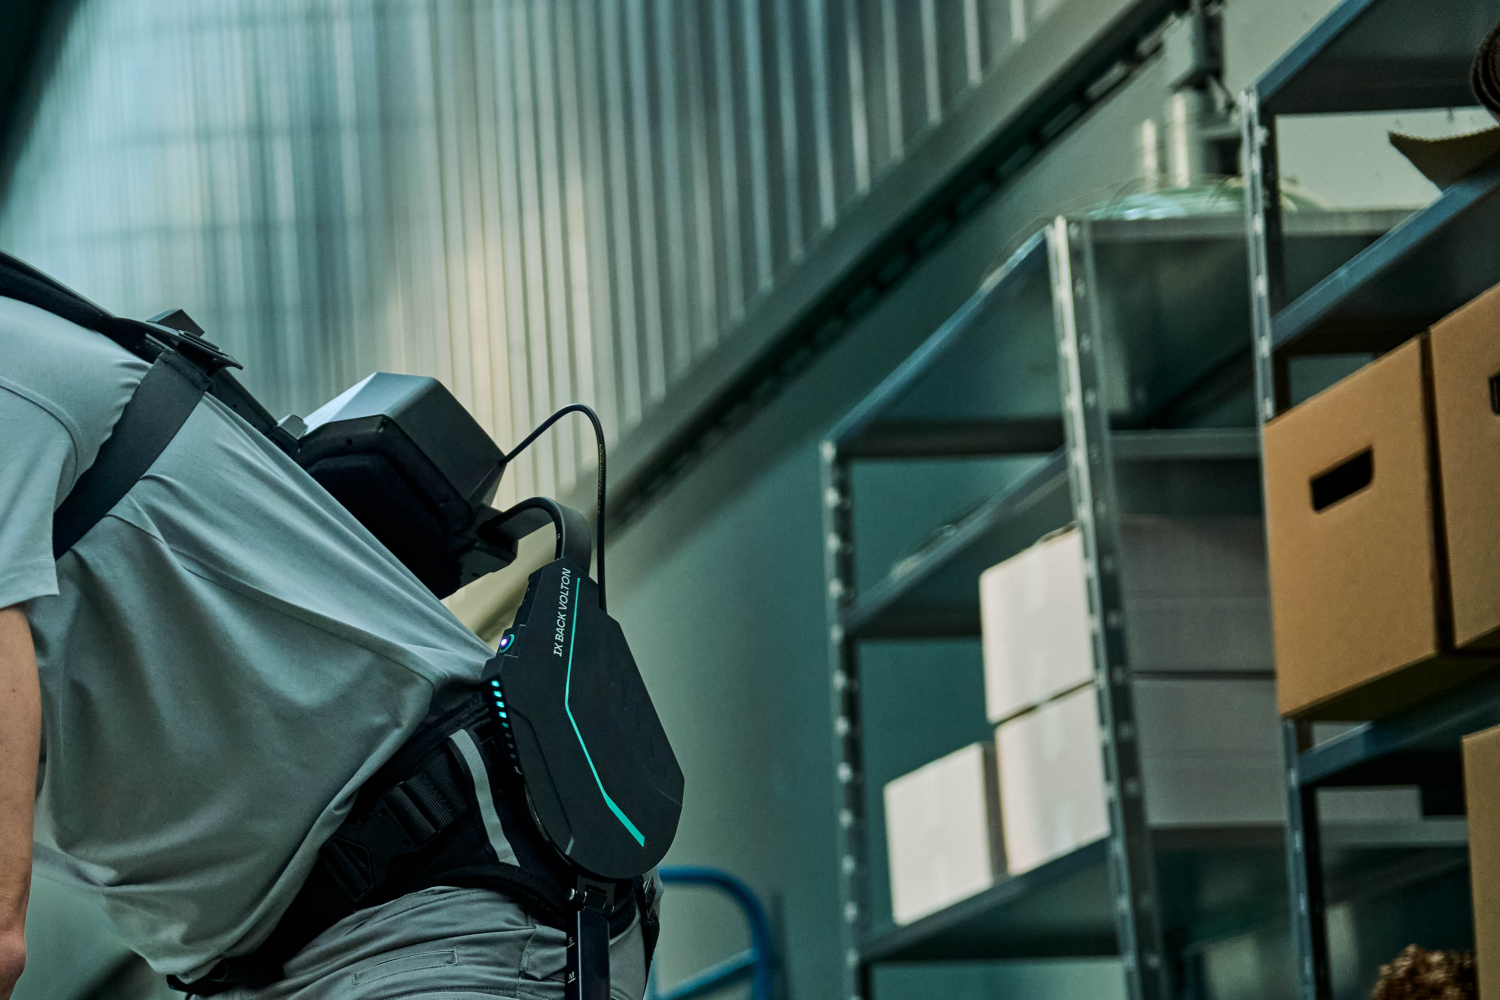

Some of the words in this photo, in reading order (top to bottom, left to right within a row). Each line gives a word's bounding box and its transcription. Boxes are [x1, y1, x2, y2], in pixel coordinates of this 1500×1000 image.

[559, 567, 571, 610] VOLTON
[555, 613, 567, 646] BACK
[553, 644, 563, 657] IX
[568, 971, 575, 981] M
